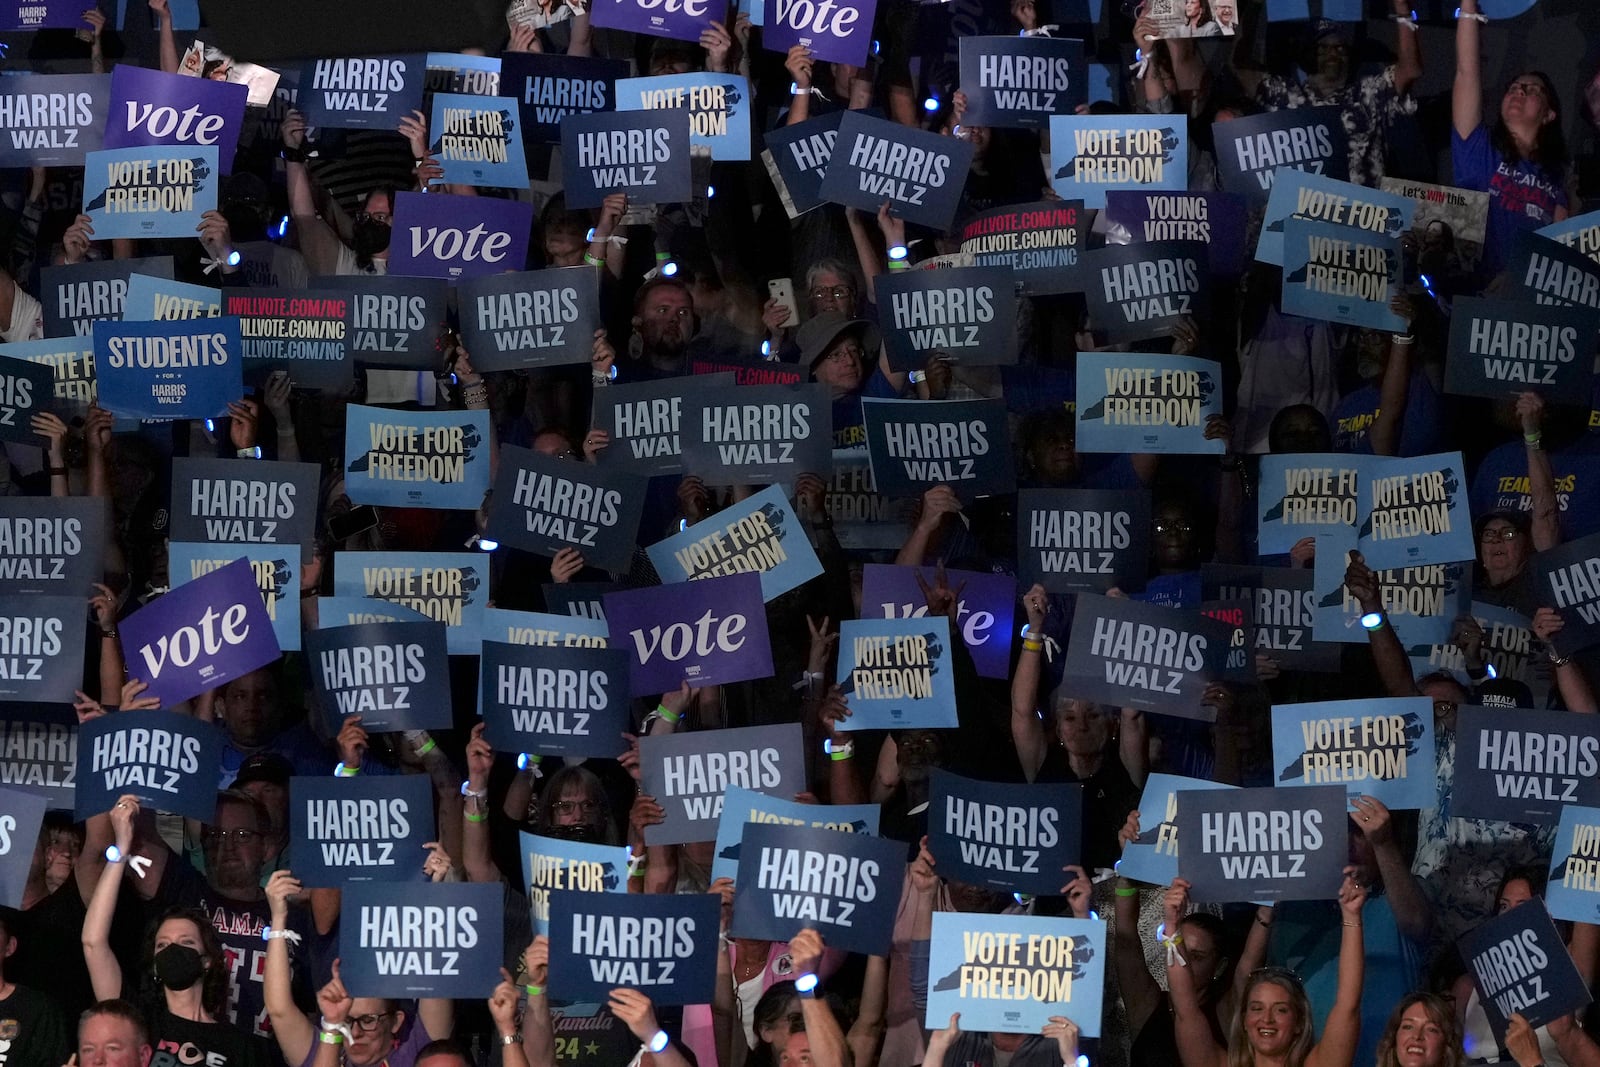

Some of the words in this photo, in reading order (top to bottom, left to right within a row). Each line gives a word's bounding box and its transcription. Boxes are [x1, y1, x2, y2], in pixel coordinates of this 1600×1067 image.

[19, 7, 46, 17] HARRIS
[610, 0, 708, 17] ote
[777, 0, 858, 37] vote
[313, 59, 405, 91] HARRIS
[463, 71, 500, 96] FOR
[980, 55, 1068, 90] HARRIS
[325, 92, 388, 111] WALZ
[525, 76, 606, 108] HARRIS
[690, 85, 725, 110] FOR
[994, 90, 1055, 111] WALZ
[126, 101, 224, 144] vote
[443, 108, 473, 134] VOTE
[475, 110, 503, 136] FOR
[11, 129, 78, 148] WALZ
[442, 136, 507, 162] FREEDOM
[578, 128, 670, 167] HARRIS
[1074, 129, 1120, 155] VOTE
[1125, 129, 1162, 155] FOR
[1235, 124, 1333, 173] HARRIS
[108, 158, 156, 188] VOTE
[157, 156, 193, 184] FOR
[592, 166, 656, 188] WALZ
[849, 133, 950, 192] HARRIS
[1075, 157, 1162, 183] FREEDOM
[105, 186, 193, 214] FREEDOM
[860, 172, 926, 205] WALZ
[1403, 186, 1426, 198] Let's
[1427, 189, 1446, 203] WIN
[1447, 193, 1468, 206] this.
[1146, 196, 1207, 220] YOUNG
[1296, 186, 1346, 223] VOTE
[1348, 201, 1389, 233] FOR
[410, 223, 511, 262] vote
[1144, 221, 1210, 243] VOTERS
[1308, 235, 1351, 267] VOTE
[1355, 243, 1387, 274] FOR
[1101, 256, 1200, 303] HARRIS
[1304, 264, 1387, 302] FREEDOM
[58, 280, 128, 320] HARR
[228, 295, 347, 318] IWILLVOTE.COM/NC
[478, 288, 578, 330] HARRIS
[892, 287, 994, 329] HARRIS
[1122, 295, 1192, 322] WALZ
[109, 334, 227, 368] STUDENTS
[494, 326, 565, 351] WALZ
[909, 326, 979, 350] WALZ
[1470, 318, 1576, 362] HARRIS
[1105, 368, 1155, 396] VOTE
[1156, 369, 1199, 396] FOR
[1484, 358, 1557, 384] WALZ
[152, 384, 186, 396] HARRIS
[703, 404, 810, 442] HARRIS
[1104, 398, 1200, 426] FREEDOM
[369, 422, 414, 452] VOTE
[424, 426, 463, 453] FOR
[885, 420, 988, 458] HARRIS
[367, 452, 464, 482] FREEDOM
[719, 443, 793, 465] WALZ
[904, 459, 975, 481] WALZ
[1285, 466, 1336, 496] VOTE
[1372, 475, 1409, 510] VOTE
[1412, 471, 1446, 503] FOR
[192, 479, 296, 519] HARRIS
[513, 469, 621, 526] HARRIS
[1283, 497, 1356, 525] FREEDO
[1496, 495, 1517, 509] for
[206, 520, 277, 542] WALZ
[527, 510, 598, 546] WALZ
[1031, 510, 1130, 549] HARRIS
[1372, 503, 1451, 541] FREEDOM
[674, 530, 731, 577] VOTE
[726, 511, 773, 551] FOR
[1041, 551, 1113, 573] WALZ
[363, 564, 415, 595] VOTE
[420, 568, 462, 596] FOR
[140, 604, 249, 678] vote
[630, 609, 746, 664] vote
[854, 636, 892, 667] VOTE
[894, 634, 928, 665] FOR
[1091, 617, 1206, 671] HARRIS
[1255, 628, 1302, 650] ALZ
[1491, 621, 1531, 653] FOR
[322, 644, 425, 689] HARRIS
[1106, 661, 1183, 694] WALZ
[336, 687, 410, 713] WALZ
[499, 665, 607, 710] HARRIS
[853, 668, 932, 700] FREEDOM
[512, 709, 589, 735] WALZ
[1301, 717, 1355, 750] VOTE
[1361, 715, 1405, 747] FOR
[93, 729, 200, 773] HARRIS
[1303, 748, 1406, 784] FREEDOM
[1479, 729, 1599, 776] HARRIS
[105, 766, 180, 793] WALZ
[664, 748, 780, 796] HARRIS
[1495, 774, 1578, 801] WALZ
[308, 799, 409, 839] HARRIS
[946, 796, 1058, 847] HARRIS
[1202, 809, 1323, 853] HARRIS
[322, 843, 394, 865] WALZ
[960, 841, 1039, 873] WALZ
[1221, 855, 1305, 879] WALZ
[530, 853, 564, 889] VOTE
[569, 859, 603, 892] FOR
[758, 848, 878, 901] HARRIS
[773, 894, 855, 926] WALZ
[361, 907, 477, 948] HARRIS
[573, 914, 695, 958] HARRIS
[376, 952, 458, 975] WALZ
[963, 931, 1022, 965] VOTE
[1027, 934, 1074, 968] FOR
[1473, 929, 1549, 1001] HARRIS
[590, 959, 674, 985] WALZ
[960, 966, 1072, 1002] FREEDOM
[1495, 976, 1549, 1027] WALZ
